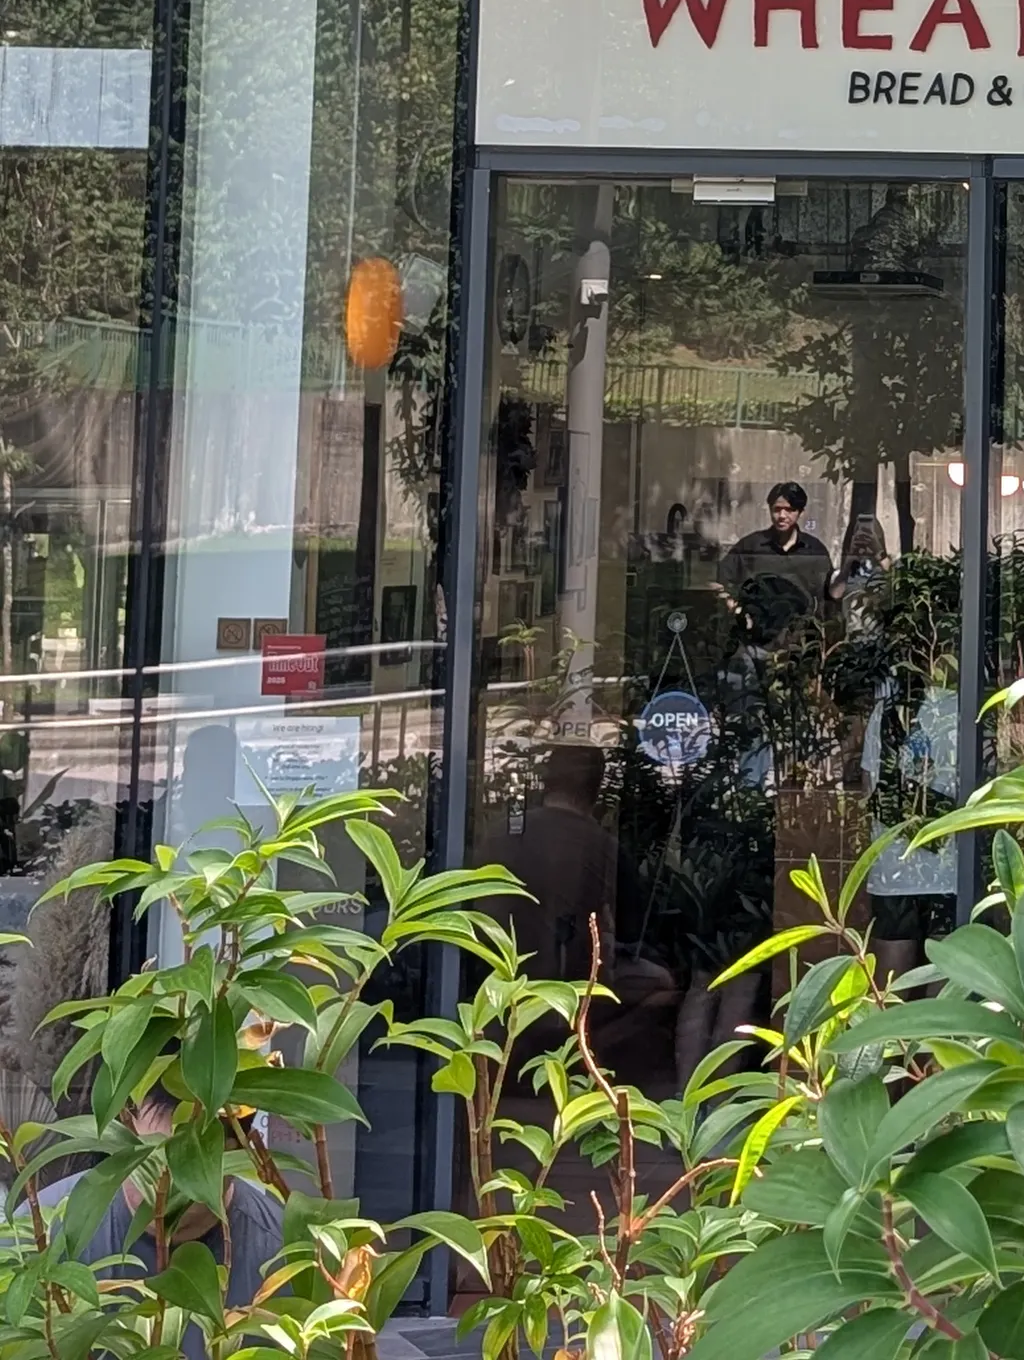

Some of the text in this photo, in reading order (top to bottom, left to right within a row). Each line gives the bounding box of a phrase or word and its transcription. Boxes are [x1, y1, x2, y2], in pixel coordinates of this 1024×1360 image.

[847, 71, 975, 106] BREAD
[986, 74, 1013, 107] &
[652, 712, 699, 728] OPEN
